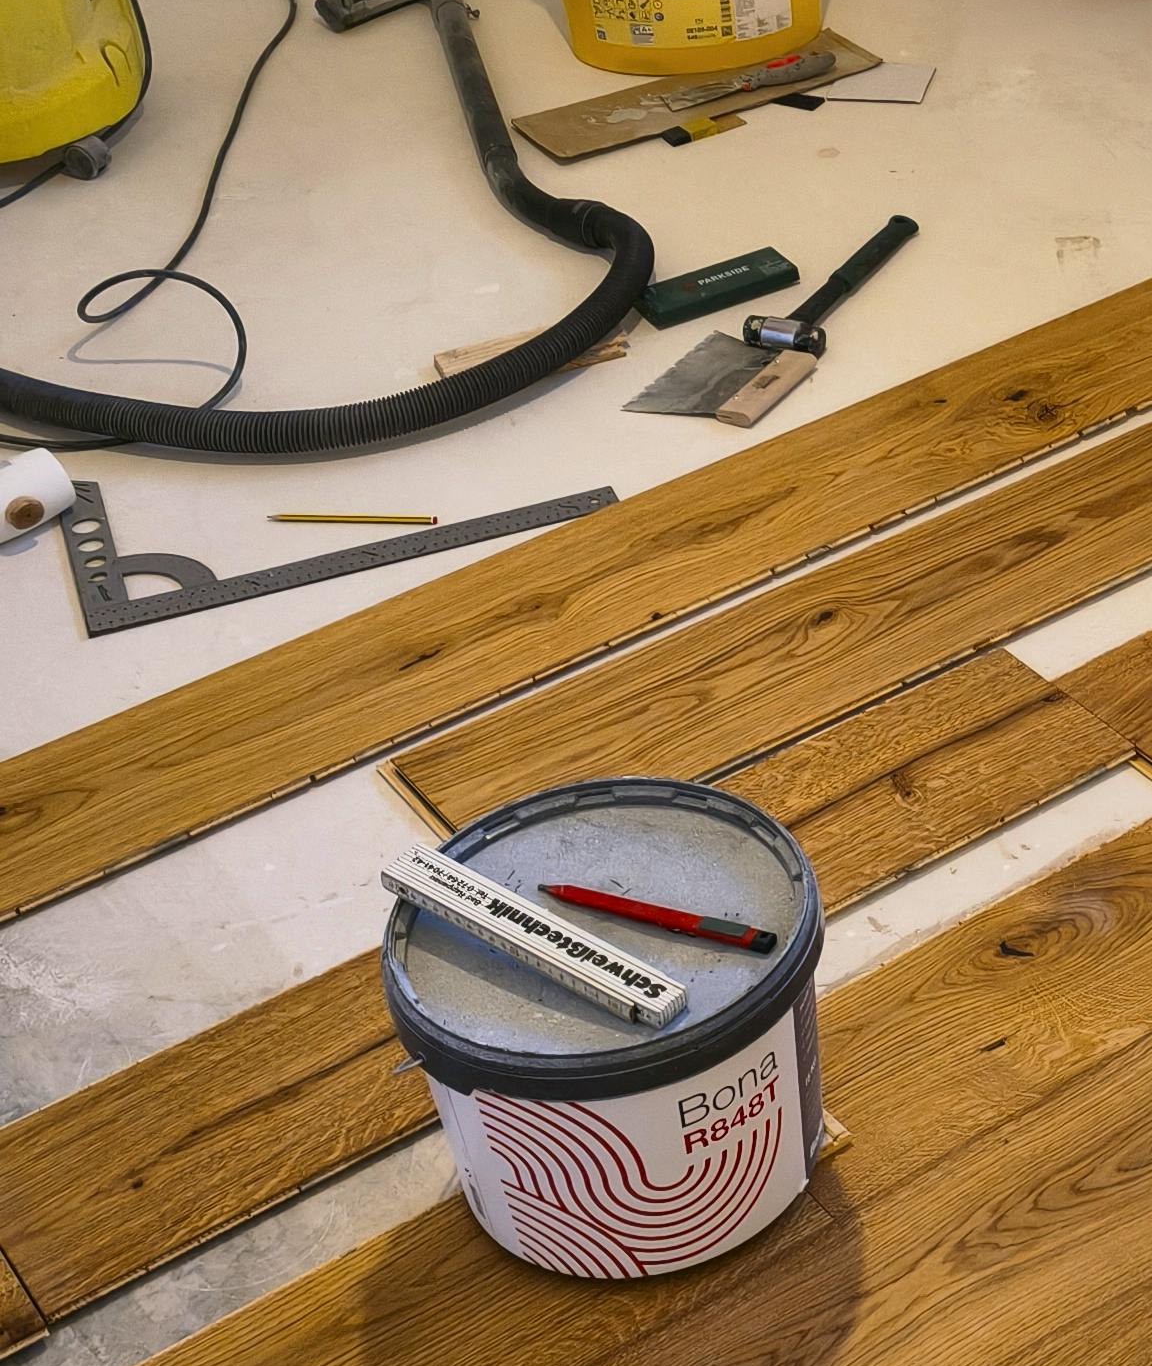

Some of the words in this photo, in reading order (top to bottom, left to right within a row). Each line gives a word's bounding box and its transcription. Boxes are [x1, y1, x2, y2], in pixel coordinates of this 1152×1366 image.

[697, 265, 750, 285] PARKSIDE
[486, 898, 667, 998] Schweißtechnik
[678, 1051, 778, 1128] Bona
[684, 1075, 779, 1154] R848T
